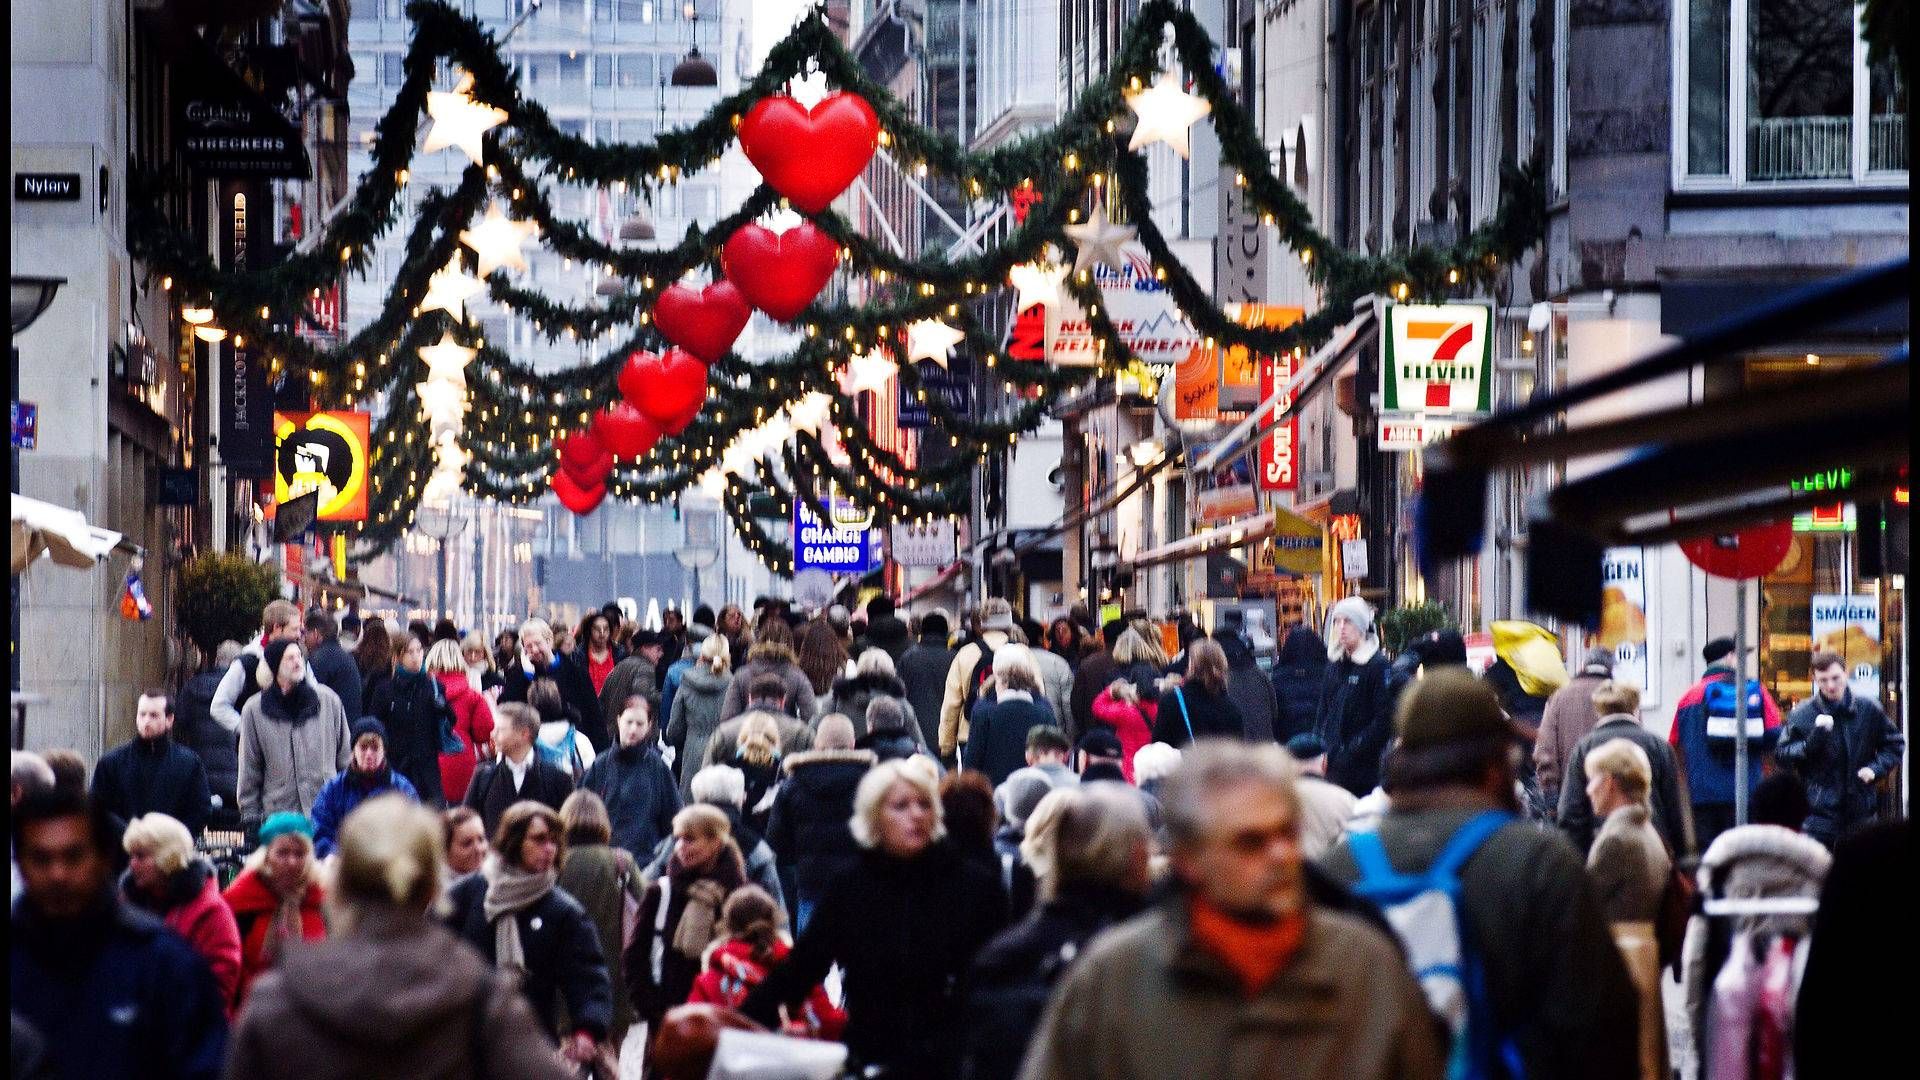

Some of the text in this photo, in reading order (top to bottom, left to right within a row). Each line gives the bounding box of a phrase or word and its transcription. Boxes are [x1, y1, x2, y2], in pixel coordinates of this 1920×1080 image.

[25, 178, 70, 196] Nytorv
[1406, 321, 1473, 407] 7
[800, 526, 862, 544] CHANGE
[803, 546, 860, 563] CAMBIO
